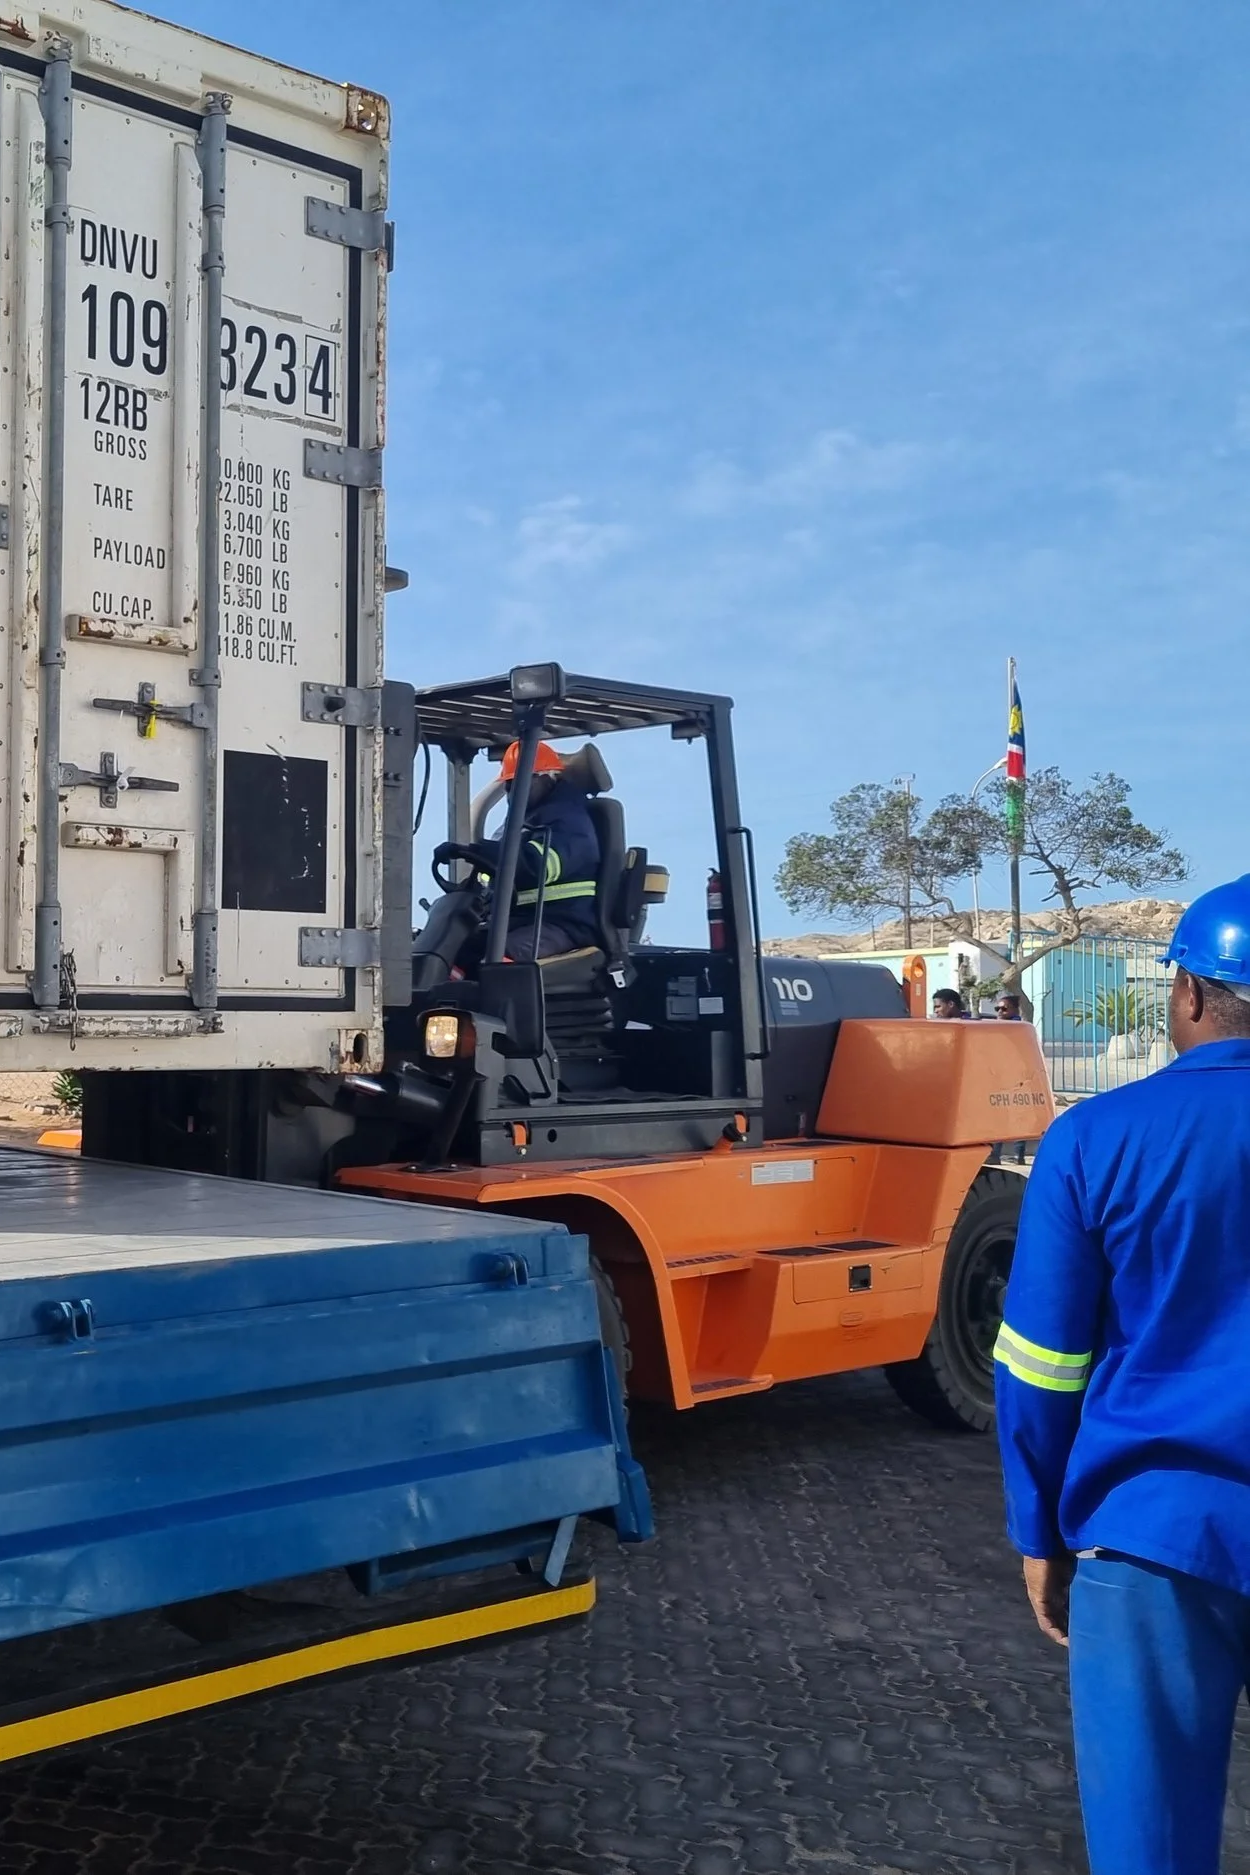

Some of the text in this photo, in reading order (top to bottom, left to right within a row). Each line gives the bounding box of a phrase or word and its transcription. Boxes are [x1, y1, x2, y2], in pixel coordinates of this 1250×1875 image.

[80, 218, 158, 280] DNVU
[81, 283, 168, 376] 109
[79, 377, 148, 431] 12RB
[94, 430, 147, 461] GROSS
[273, 468, 290, 491] KG
[94, 483, 290, 541] TARE 3,040 KG
[273, 491, 288, 513] LB
[94, 537, 166, 570] PAYLOAD
[273, 569, 289, 591] KG
[224, 533, 288, 564] 6,700 LB
[93, 591, 155, 621] CU.CAP.
[259, 617, 297, 642] CU.M.
[273, 592, 287, 614] LB
[259, 641, 297, 666] CU.FT.
[772, 977, 813, 1002] 110
[1013, 1092, 1031, 1106] 490
